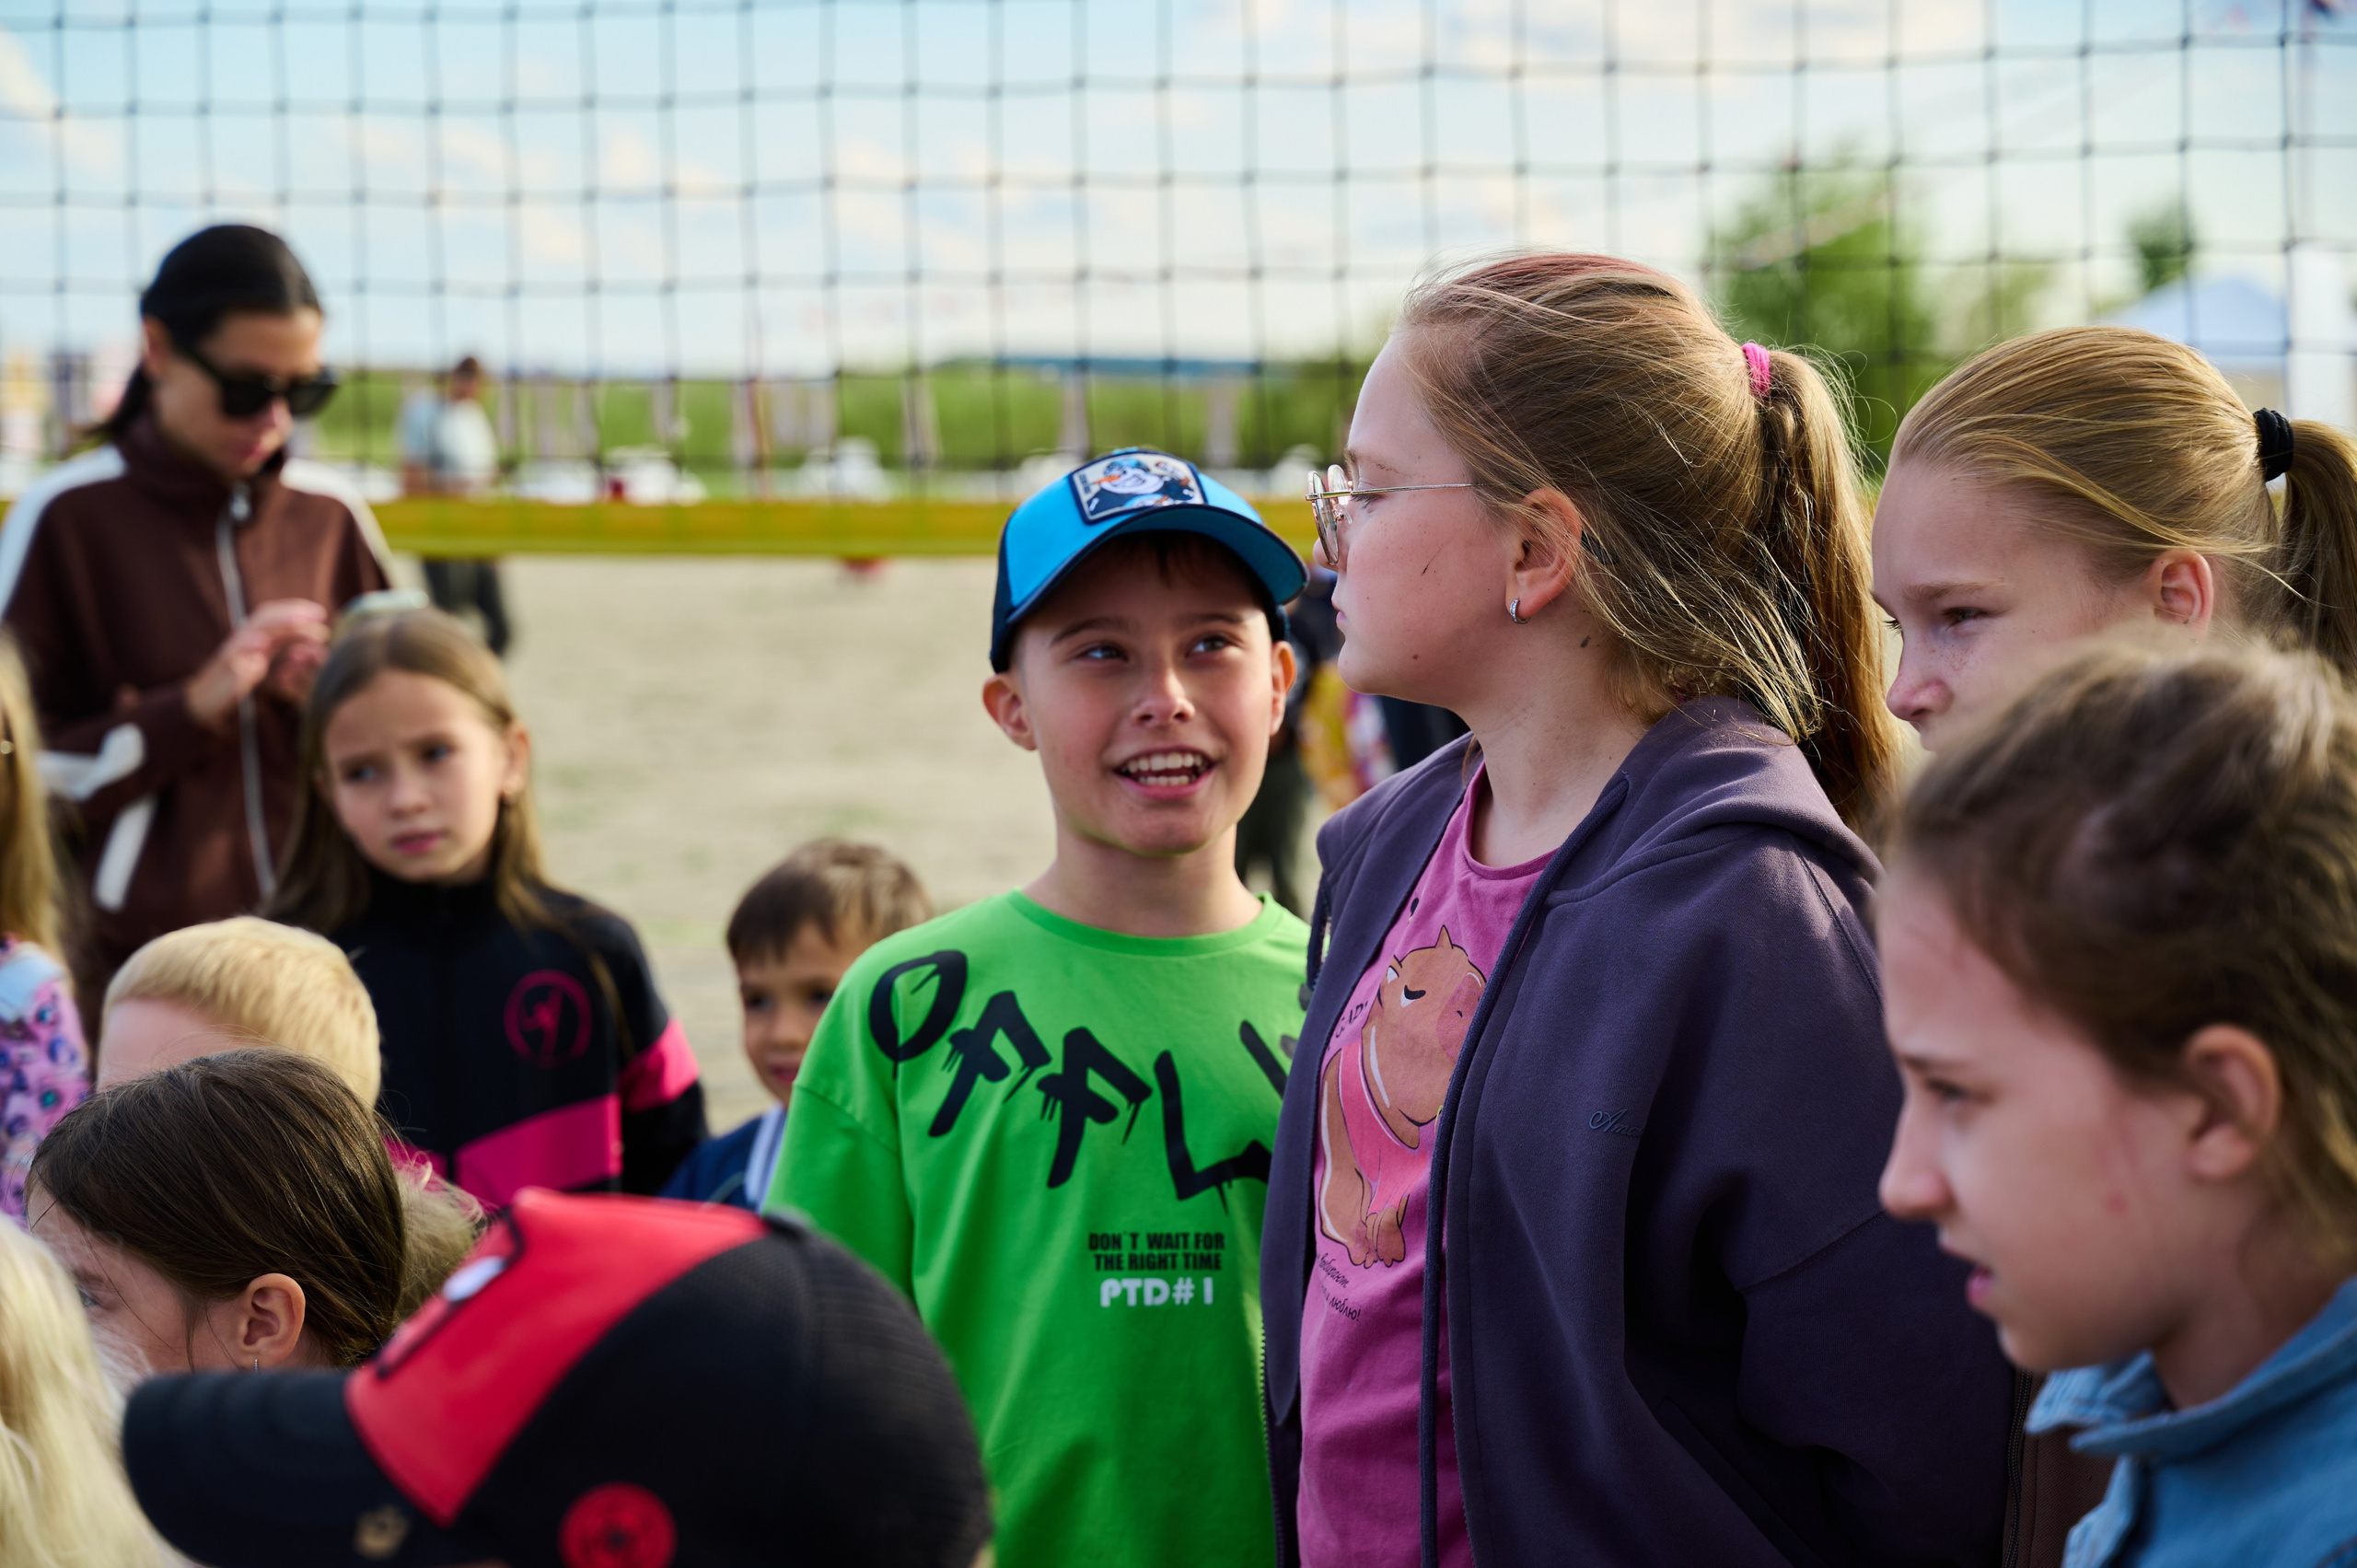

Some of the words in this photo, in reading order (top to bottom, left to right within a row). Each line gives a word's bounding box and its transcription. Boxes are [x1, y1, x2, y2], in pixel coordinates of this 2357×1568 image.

[1147, 1232, 1190, 1250] WAIT
[1195, 1232, 1225, 1250] FOR
[1094, 1253, 1123, 1271] THE
[1129, 1253, 1178, 1271] RIGHT
[1183, 1253, 1222, 1271] TIME
